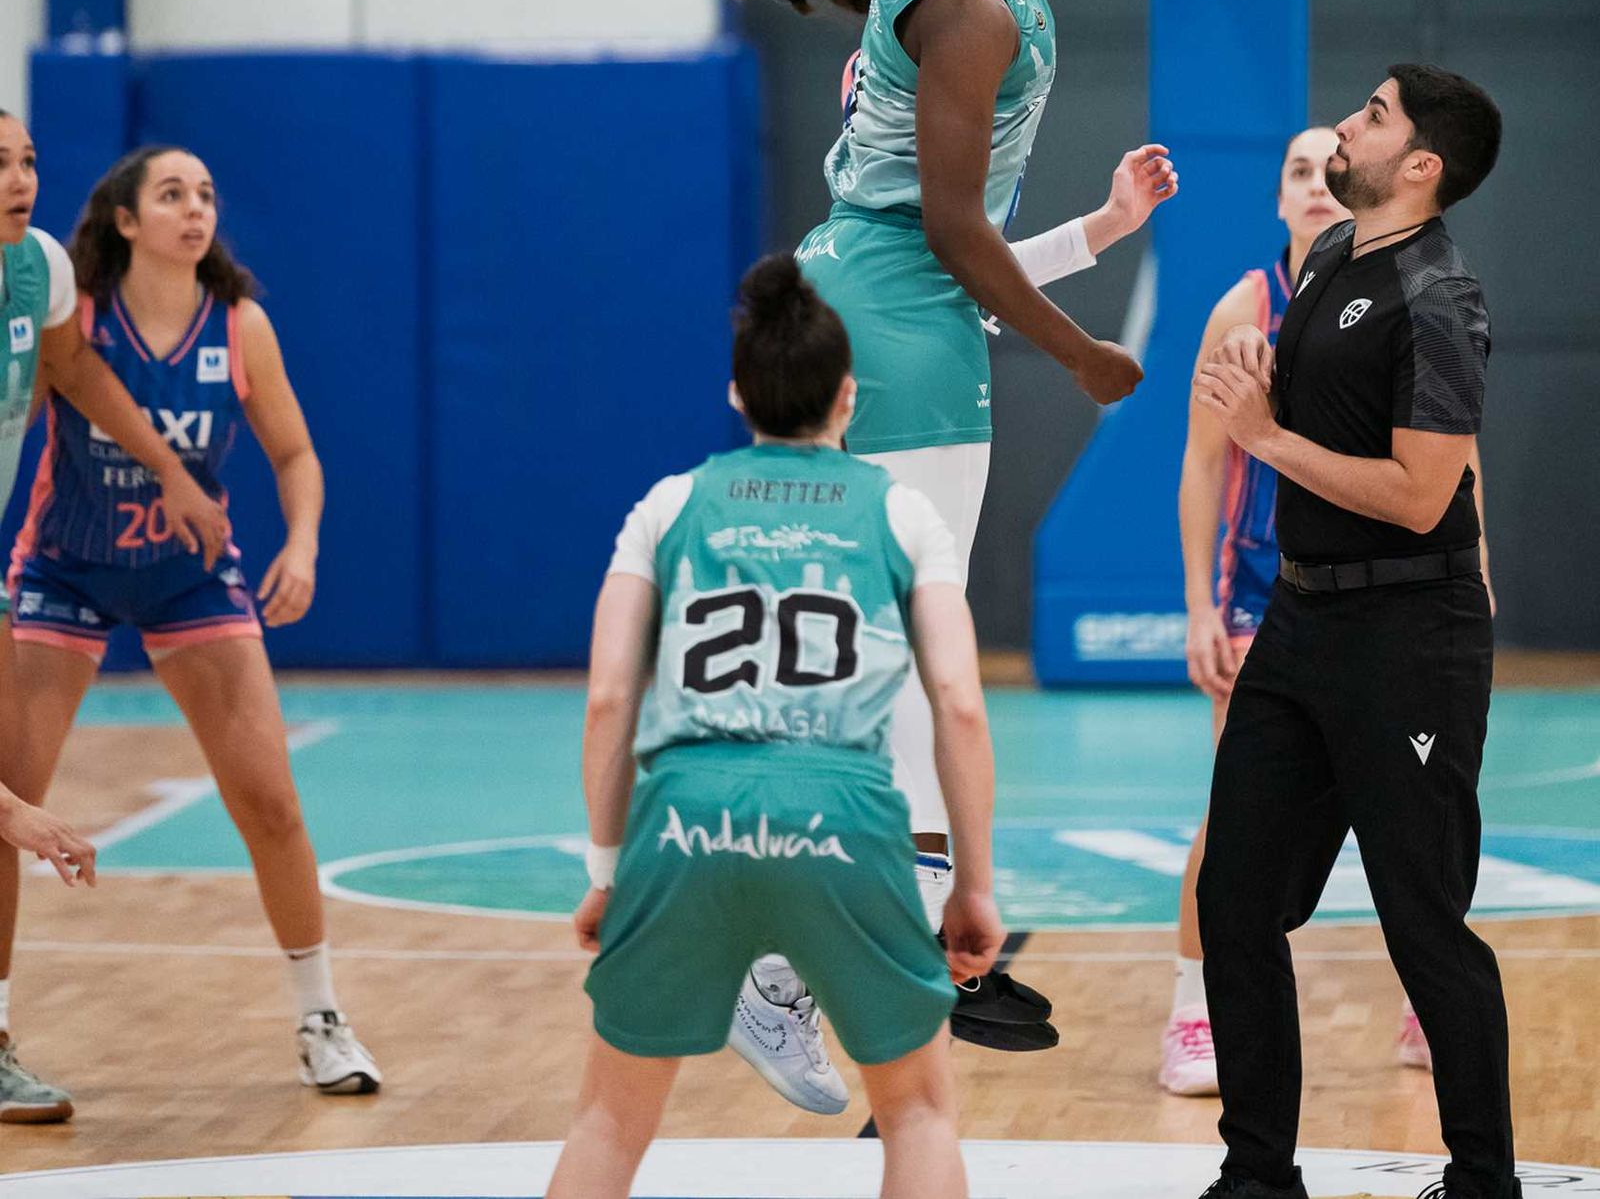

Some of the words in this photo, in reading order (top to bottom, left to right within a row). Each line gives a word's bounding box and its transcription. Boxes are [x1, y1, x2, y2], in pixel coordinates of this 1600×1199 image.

[728, 478, 848, 504] GRETTER
[114, 498, 174, 549] 20
[681, 587, 861, 695] 20
